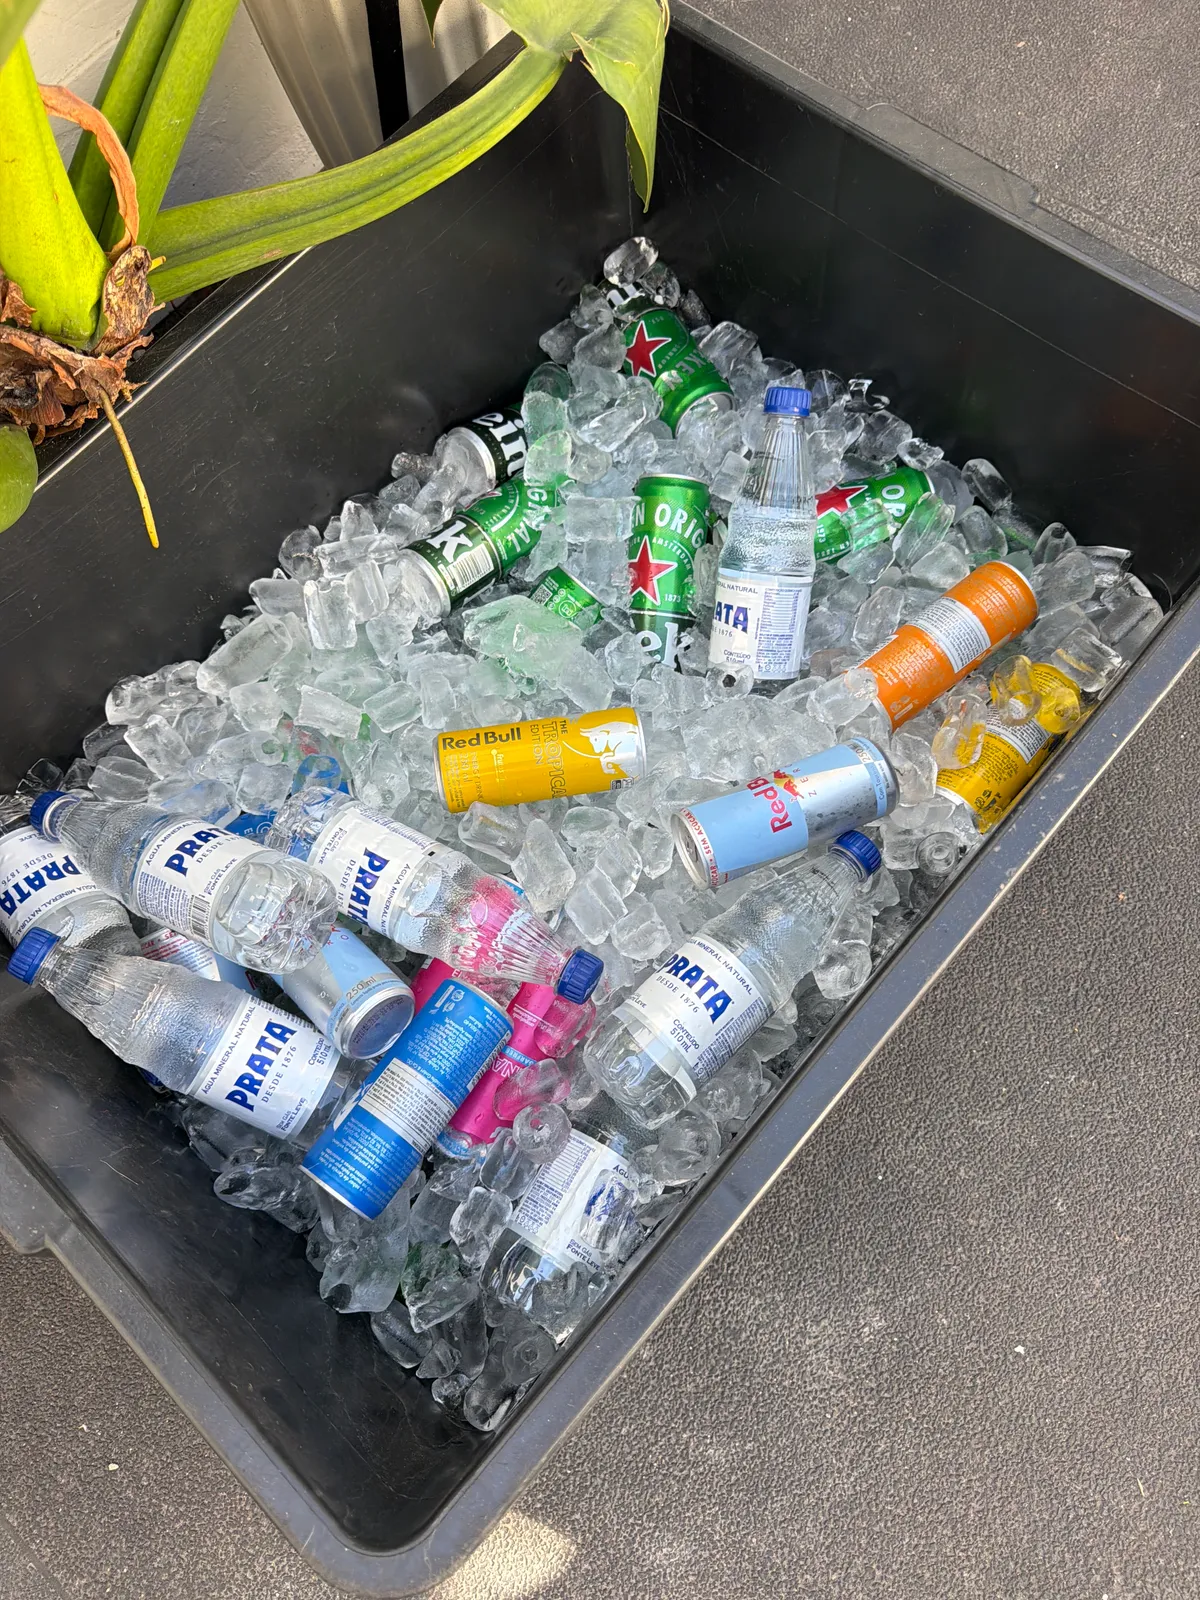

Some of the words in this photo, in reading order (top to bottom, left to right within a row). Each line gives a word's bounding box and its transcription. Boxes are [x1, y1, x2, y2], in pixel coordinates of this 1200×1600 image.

[442, 732, 481, 751] Red
[484, 727, 522, 744] Bull
[530, 724, 544, 765] EDITION
[753, 785, 793, 834] Red
[161, 822, 192, 844] MINERAL
[700, 835, 712, 855] SEM
[23, 852, 54, 870] DESDE
[196, 841, 224, 864] DESDE
[222, 858, 238, 873] LEVE
[319, 845, 331, 865] LEVE
[0, 854, 82, 917] PRATA
[1, 869, 20, 887] 1876
[340, 859, 356, 890] DESDE
[41, 889, 77, 909] MINERAL
[382, 886, 398, 922] MINERAL
[16, 908, 42, 936] NATURAL
[696, 941, 722, 963] MINERAL
[722, 960, 752, 995] NATURAL
[346, 983, 365, 1000] 250
[365, 976, 377, 986] ml
[656, 976, 680, 993] DESDE
[679, 993, 700, 1014] 1876
[201, 1076, 217, 1095] ÁGUA
[215, 1040, 239, 1076] MINERAL
[234, 1005, 256, 1040] NATURAL
[669, 1029, 685, 1046] 510
[225, 1020, 298, 1112] PRATA
[316, 1051, 328, 1066] 510
[261, 1072, 284, 1103] DESDE
[281, 1046, 297, 1068] 1876
[281, 1114, 294, 1132] FONTE
[292, 1097, 305, 1116] LEVE
[566, 1244, 588, 1263] FONTE
[586, 1258, 600, 1271] LEVE
